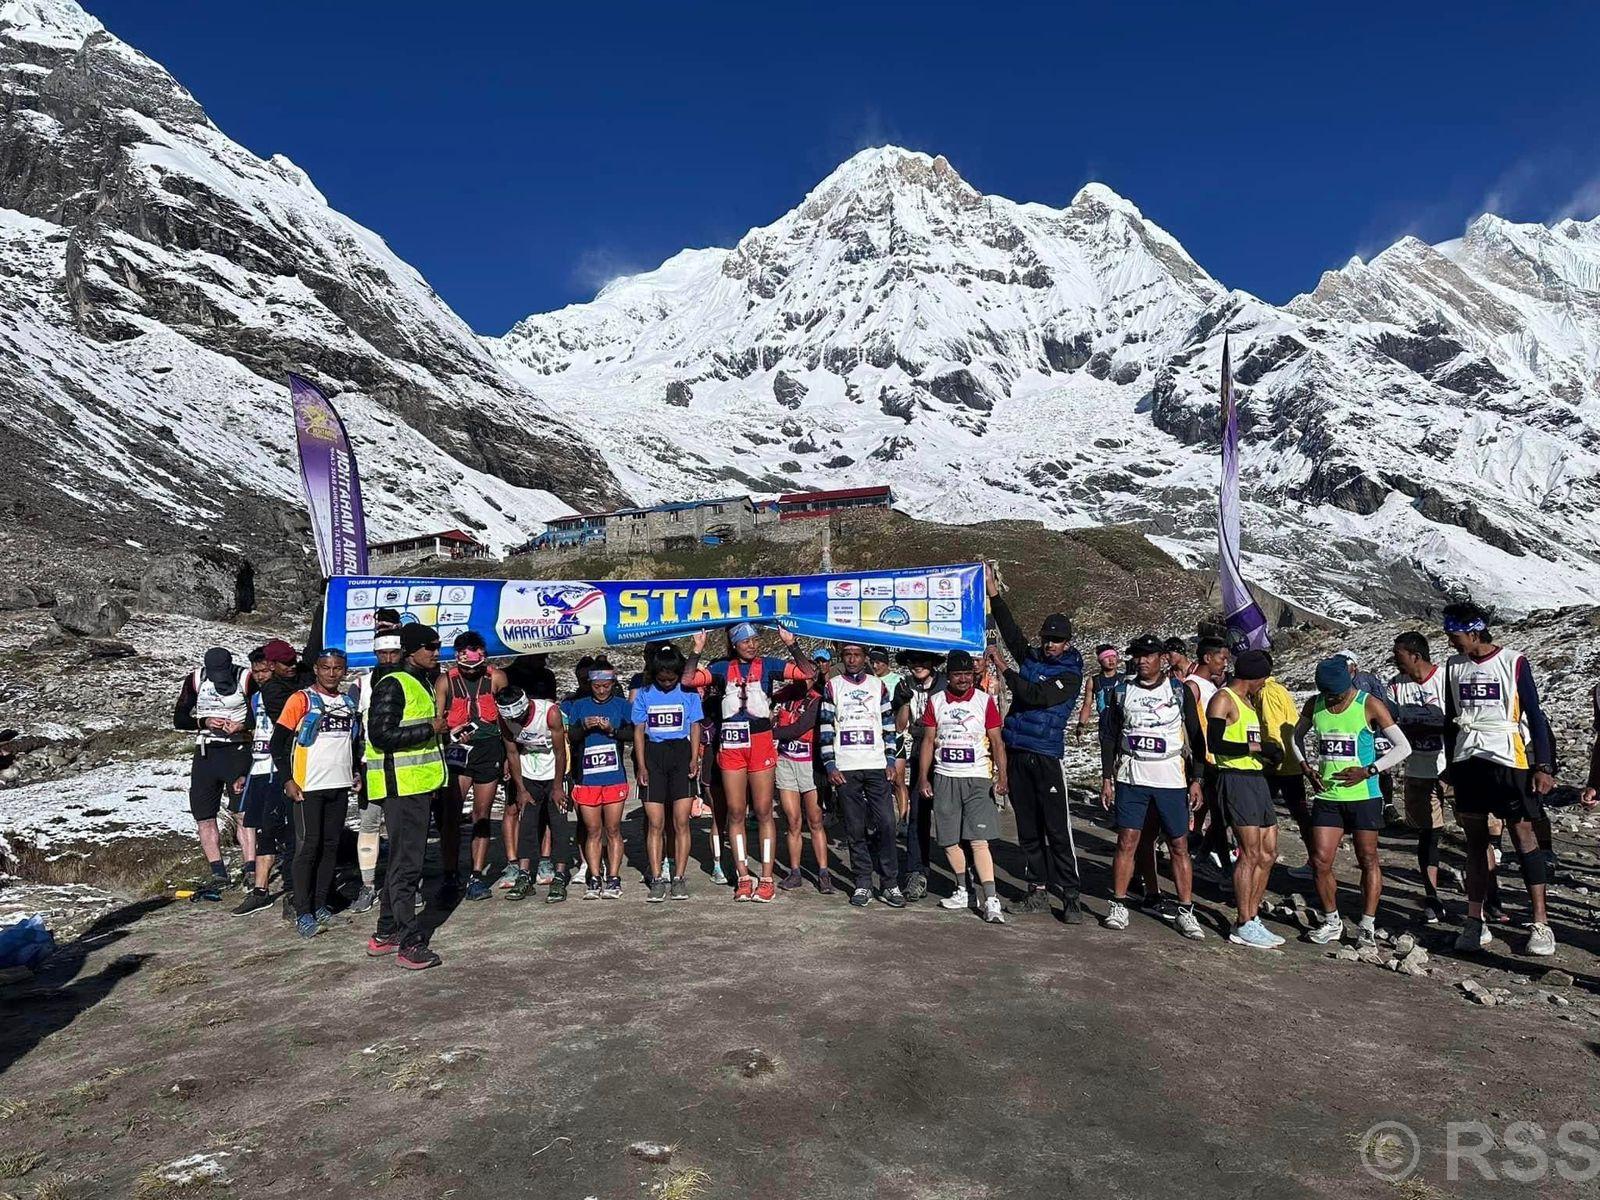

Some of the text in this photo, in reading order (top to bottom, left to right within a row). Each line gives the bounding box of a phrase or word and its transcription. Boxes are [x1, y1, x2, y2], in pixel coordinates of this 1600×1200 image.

[619, 583, 801, 625] START
[502, 624, 573, 642] MARATHON
[522, 641, 542, 650] JUNE
[657, 713, 674, 725] 09
[725, 730, 739, 741] 03
[849, 731, 866, 743] 54
[1137, 737, 1155, 750] 49
[1327, 741, 1343, 753] 34
[591, 754, 607, 766] 02
[949, 750, 965, 761] 53
